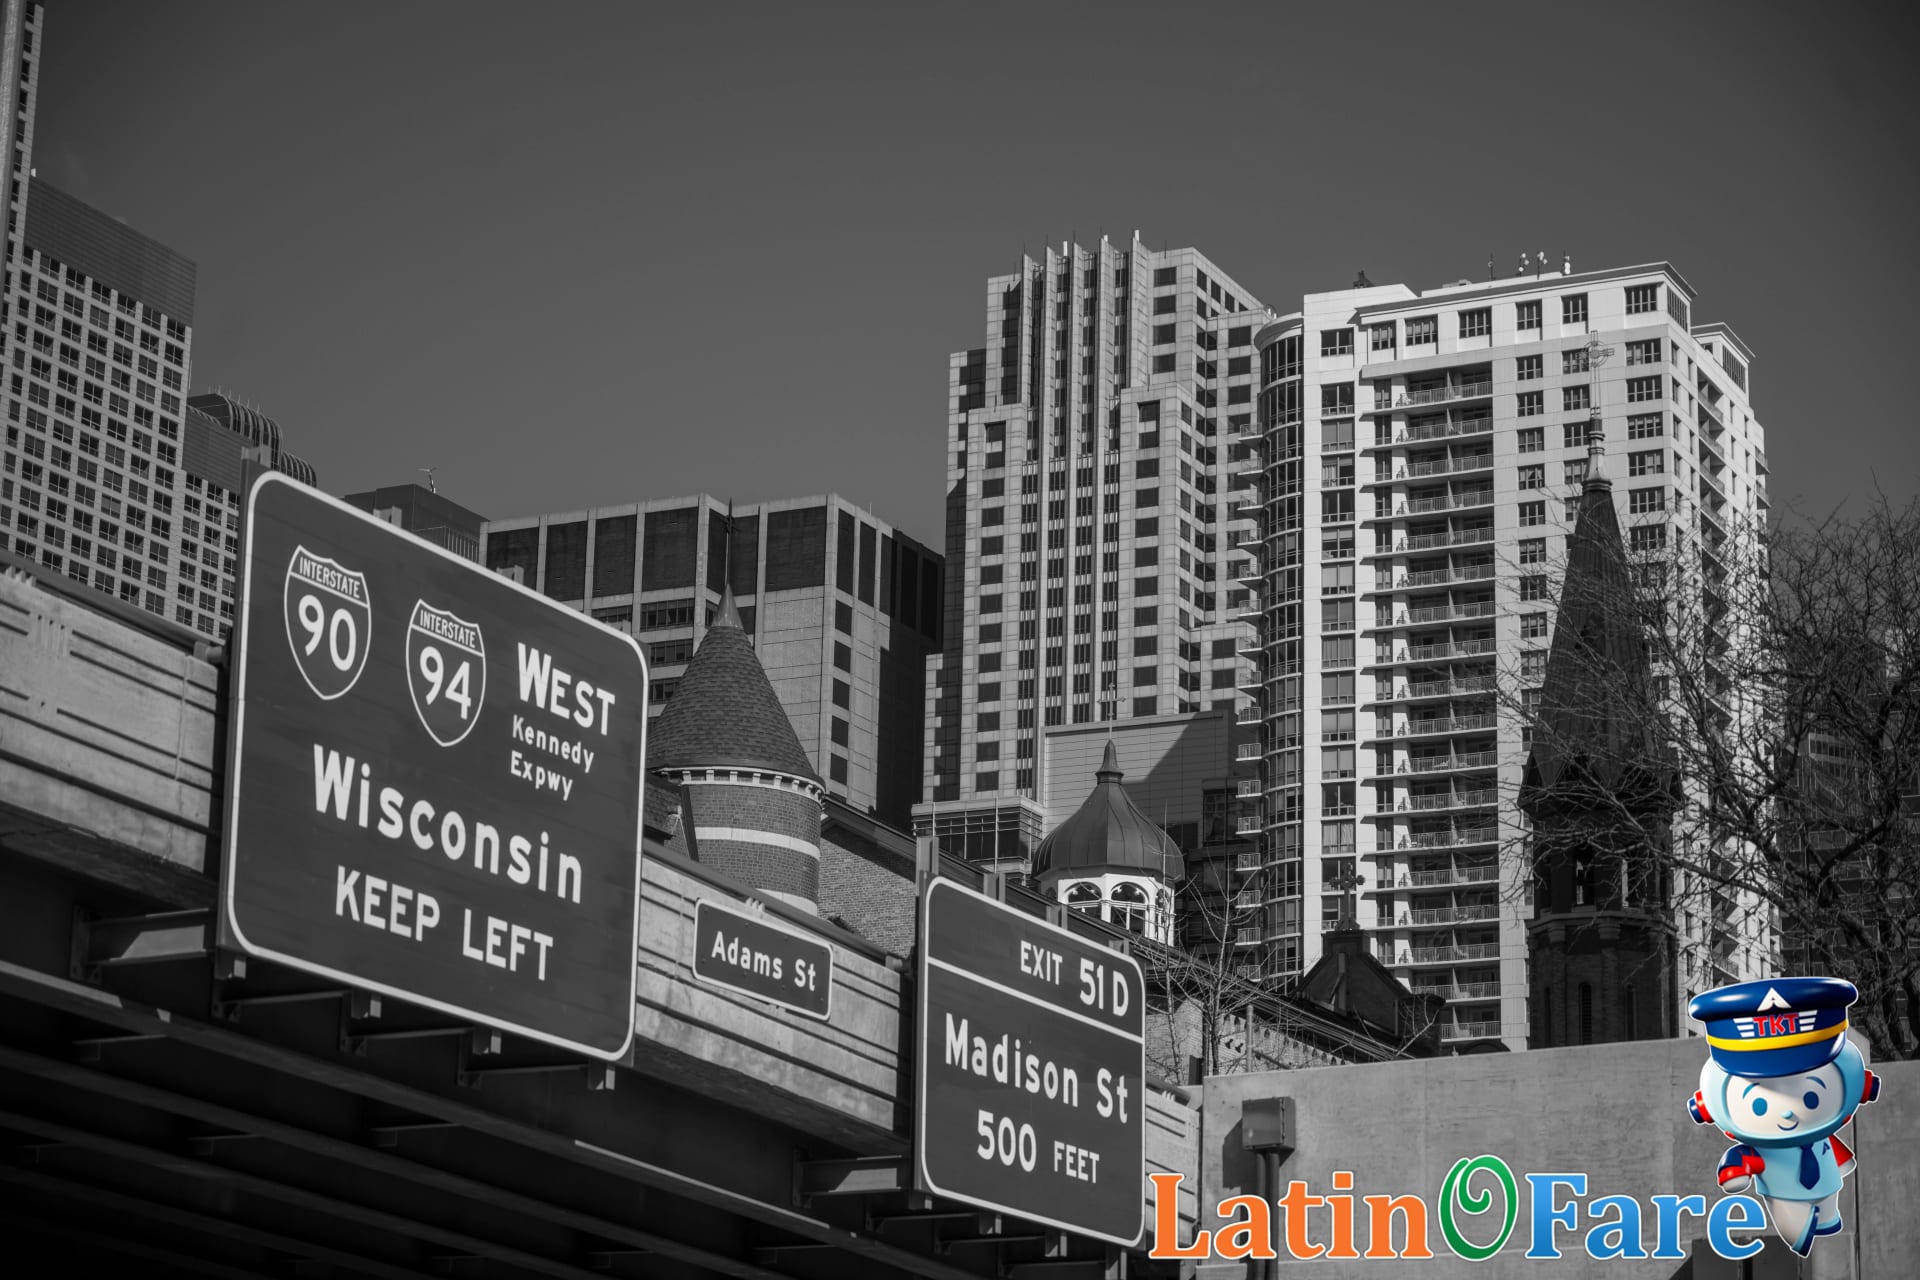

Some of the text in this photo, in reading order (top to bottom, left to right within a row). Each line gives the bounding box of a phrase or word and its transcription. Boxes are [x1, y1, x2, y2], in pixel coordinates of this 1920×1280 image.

[299, 555, 361, 597] INTERSTATE
[298, 595, 357, 673] 90
[419, 609, 477, 647] INTERSTATE
[419, 646, 472, 721] 94
[517, 641, 616, 737] WEST
[510, 750, 574, 802] Expwy
[512, 714, 595, 774] Kennedy
[313, 743, 582, 905] Wisconsin
[335, 865, 554, 981] KEEP LEFT
[711, 930, 817, 992] Adams St
[1020, 939, 1064, 986] EXIT
[945, 1012, 1129, 1124] Madison St
[976, 1108, 1100, 1184] 500 FEET
